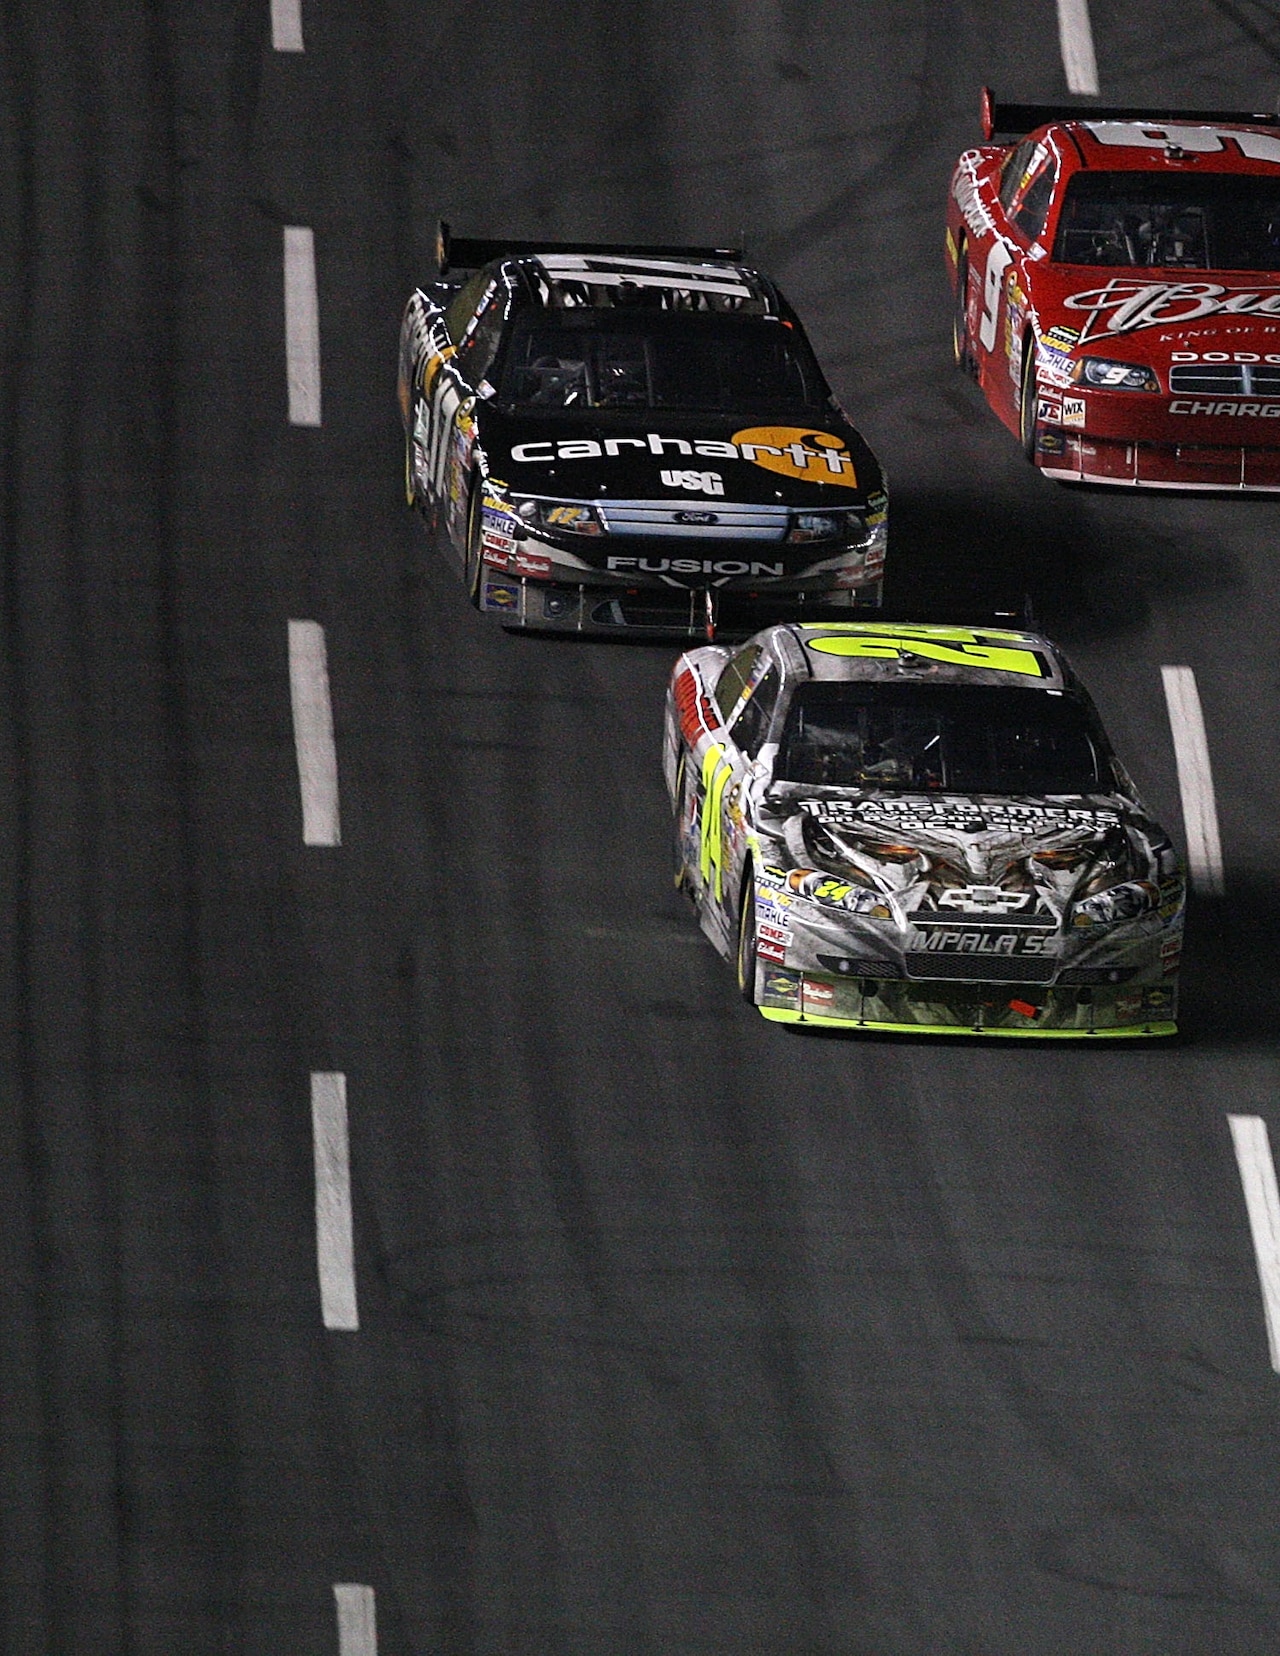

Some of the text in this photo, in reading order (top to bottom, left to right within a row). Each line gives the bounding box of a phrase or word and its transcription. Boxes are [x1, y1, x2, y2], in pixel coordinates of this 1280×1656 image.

[979, 240, 1015, 354] 9
[1159, 329, 1217, 342] KING
[1100, 367, 1133, 385] 9
[1064, 401, 1083, 416] WIX
[511, 433, 852, 473] carhartt
[660, 469, 726, 496] USG
[547, 506, 582, 525] 17
[678, 511, 711, 524] Ford
[607, 556, 784, 576] FUSION
[798, 801, 1120, 823] TRANSFORMERS
[900, 821, 1034, 835] OCT 20
[814, 879, 853, 902] 24
[760, 924, 784, 941] COMP
[908, 931, 1029, 954] MPALA
